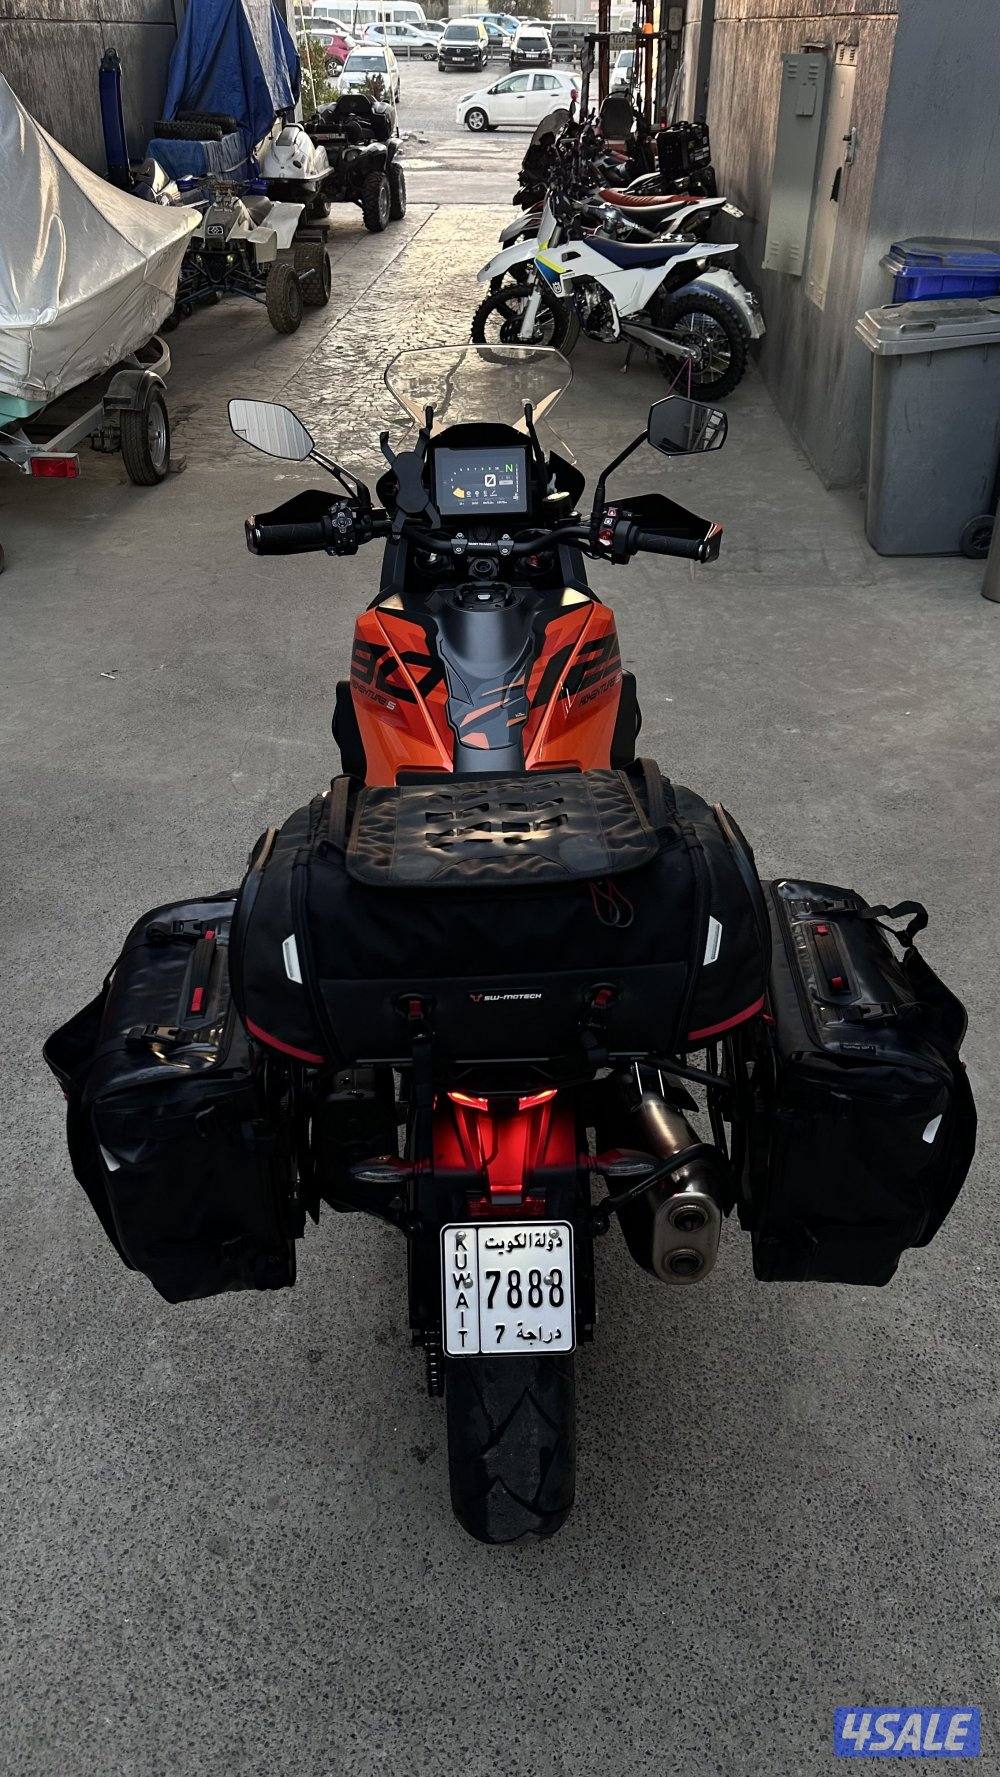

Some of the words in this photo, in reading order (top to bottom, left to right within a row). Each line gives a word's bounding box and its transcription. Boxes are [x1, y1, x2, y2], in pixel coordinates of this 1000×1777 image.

[505, 464, 513, 472] N
[386, 700, 397, 710] S
[484, 993, 542, 1002] SW-MOTECH
[485, 1232, 532, 1255] الكويت
[534, 1232, 563, 1252] دولة
[452, 1233, 472, 1348] KUWAIT
[485, 1268, 565, 1310] 7888
[495, 1324, 506, 1344] 7
[516, 1322, 562, 1346] دراجة
